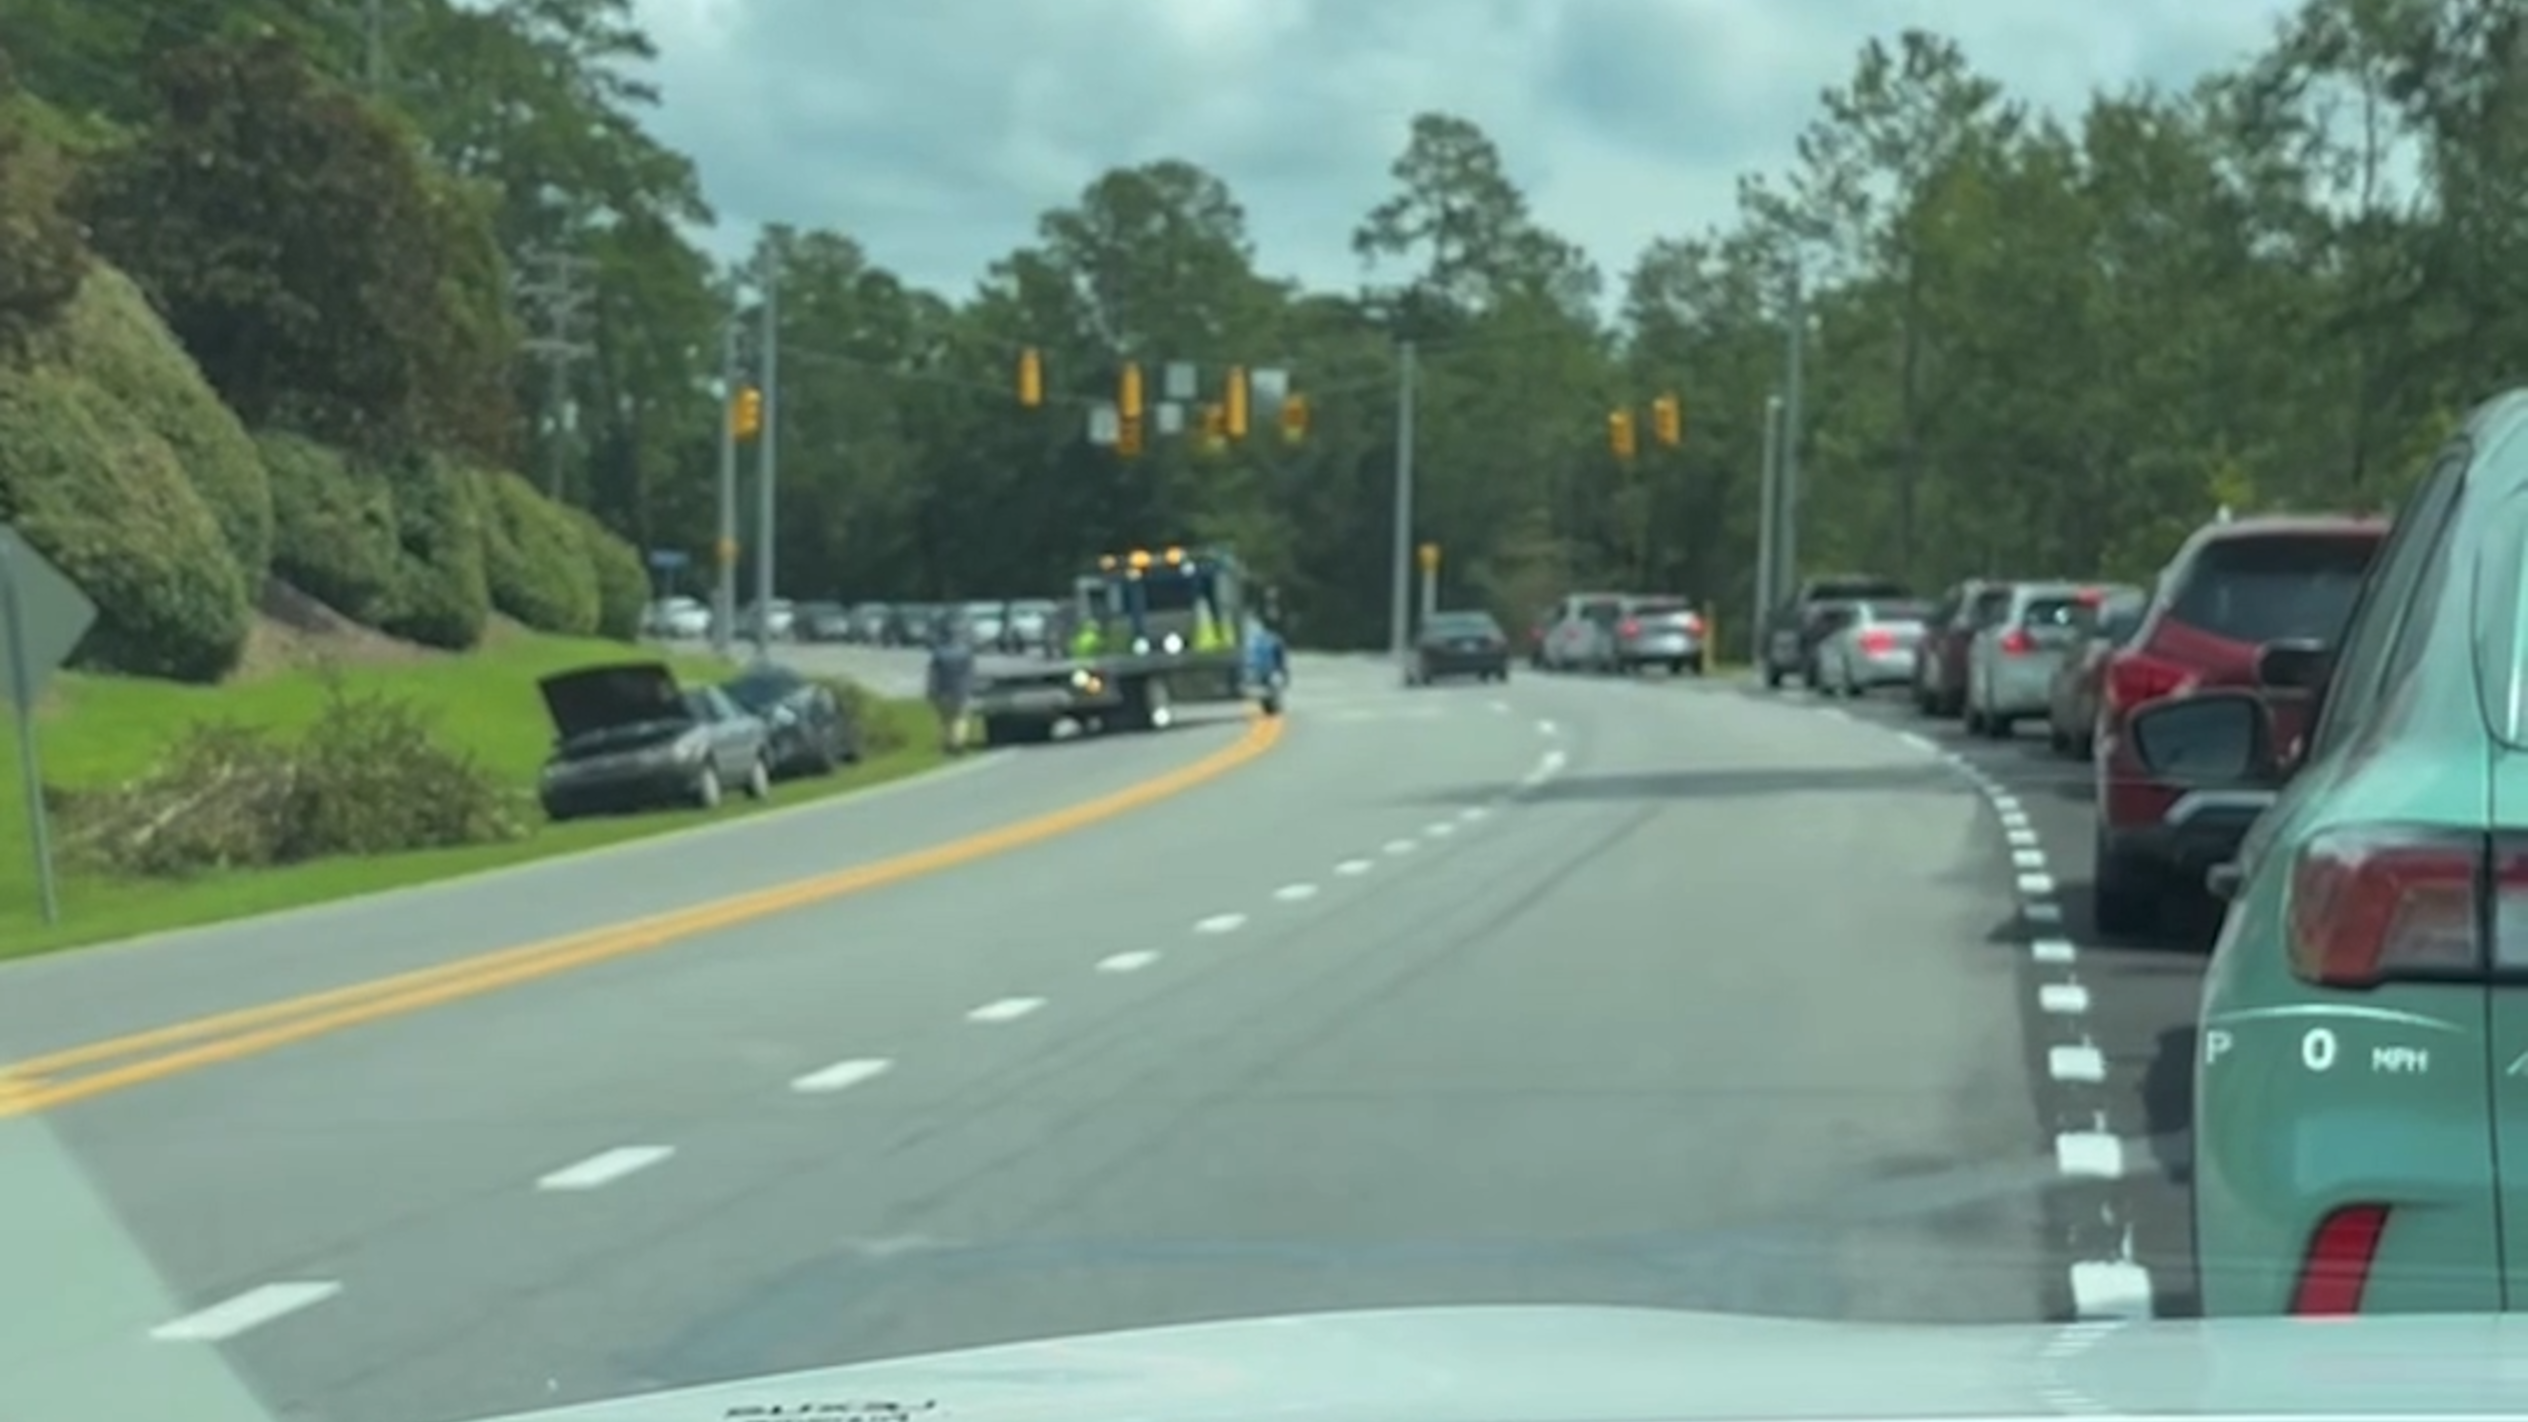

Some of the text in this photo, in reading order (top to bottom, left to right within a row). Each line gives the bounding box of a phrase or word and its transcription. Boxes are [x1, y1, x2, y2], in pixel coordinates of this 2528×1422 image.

[2205, 1027, 2429, 1073] P 0 MPH
